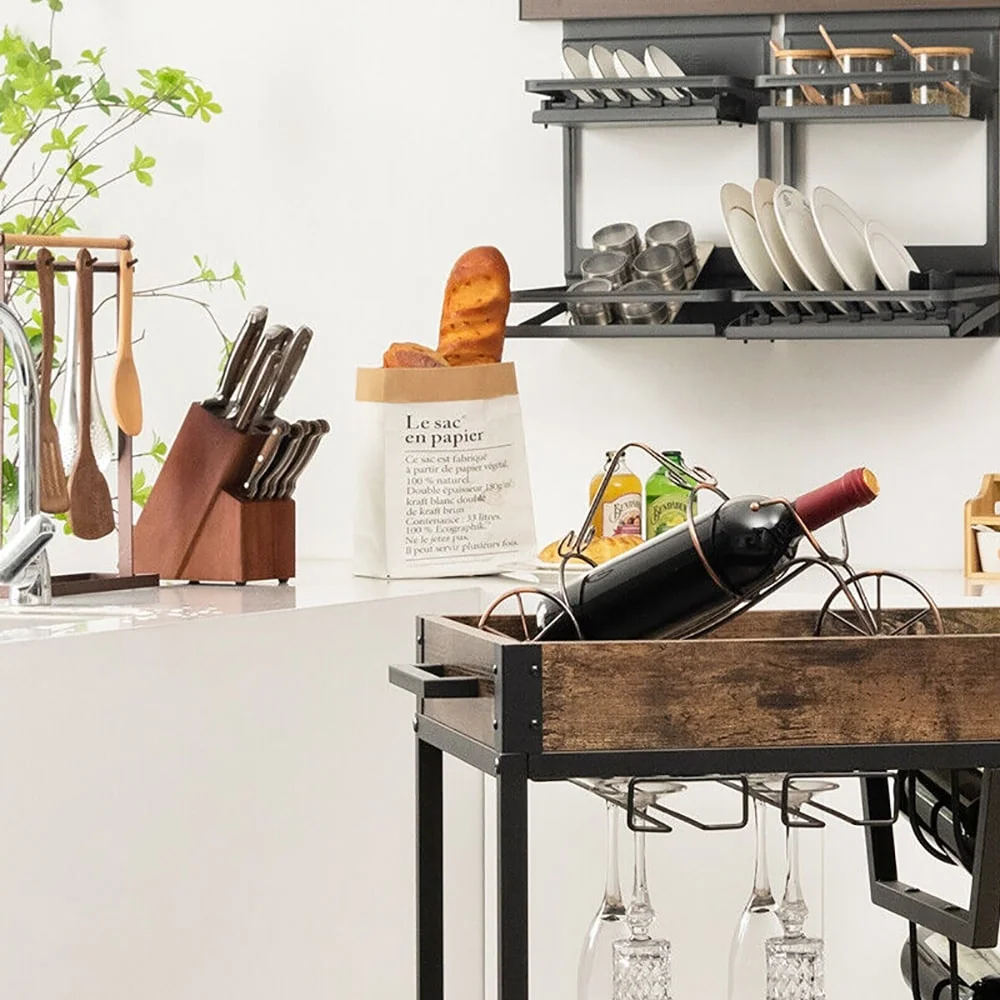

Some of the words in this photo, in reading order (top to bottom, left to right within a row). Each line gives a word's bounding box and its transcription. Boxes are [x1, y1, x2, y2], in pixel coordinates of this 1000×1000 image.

[406, 414, 430, 430] Le
[405, 433, 426, 444] en
[431, 429, 484, 448] papier
[405, 456, 418, 464] Ce
[421, 456, 434, 464] sac
[437, 455, 450, 463] est
[413, 465, 439, 476] partir
[441, 463, 453, 473] de
[455, 463, 482, 477] papier
[406, 486, 441, 495] Double
[406, 508, 417, 516] de
[443, 506, 465, 515] brun
